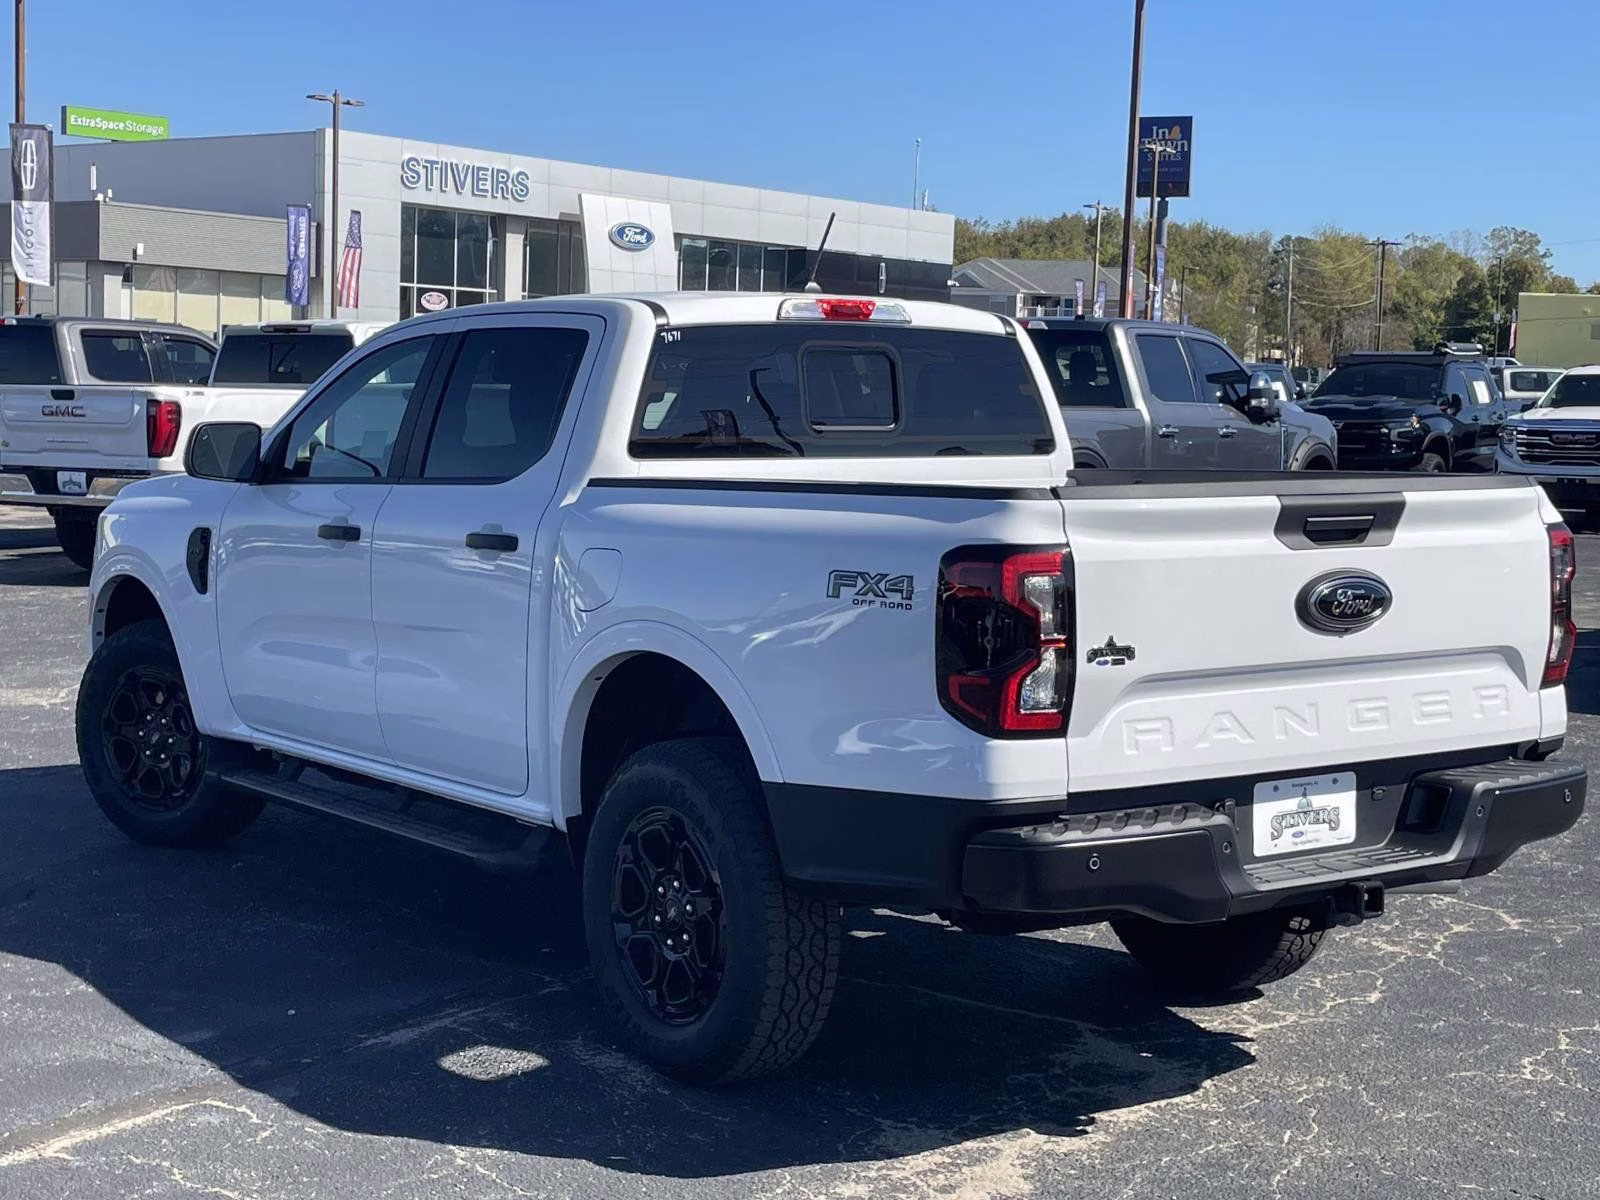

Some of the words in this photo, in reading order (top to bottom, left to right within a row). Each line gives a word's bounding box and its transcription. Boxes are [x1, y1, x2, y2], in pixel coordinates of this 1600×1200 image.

[125, 120, 164, 137] Storage
[1152, 126, 1169, 139] In
[401, 155, 530, 201] STIVERS
[623, 227, 648, 243] Ford
[42, 405, 86, 417] GMC
[826, 569, 914, 601] FX4
[852, 598, 876, 608] OFF
[880, 601, 913, 611] ROAD
[1332, 588, 1376, 616] Ford
[1122, 683, 1510, 755] RANGER
[1270, 806, 1340, 841] STIVERS
